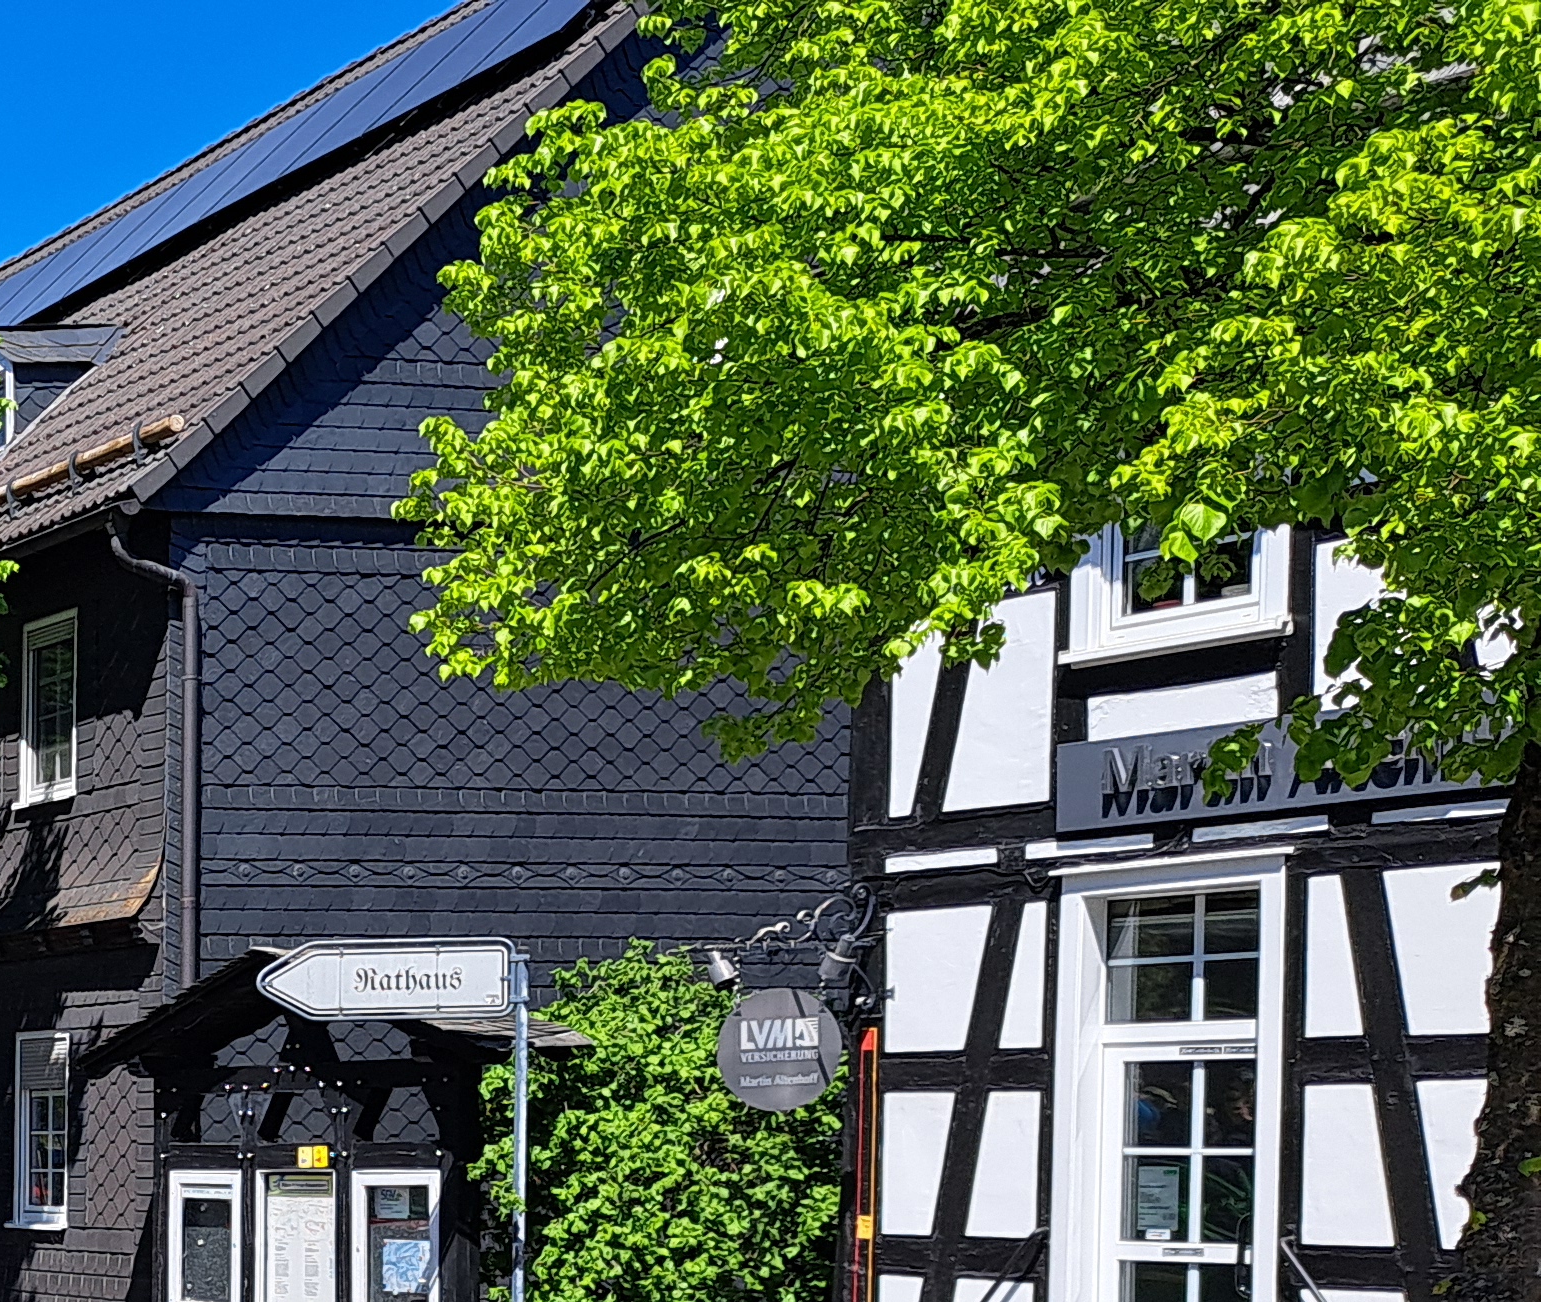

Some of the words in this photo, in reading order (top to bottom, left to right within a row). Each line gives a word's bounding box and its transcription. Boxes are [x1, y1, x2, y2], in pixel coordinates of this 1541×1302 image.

[1102, 742, 1274, 795] Marn
[353, 966, 462, 996] Rathaus
[740, 1018, 793, 1050] LVM
[740, 1049, 819, 1063] VERSICHERUNG
[740, 1076, 772, 1087] Martin
[774, 1073, 818, 1085] Altenhoff
